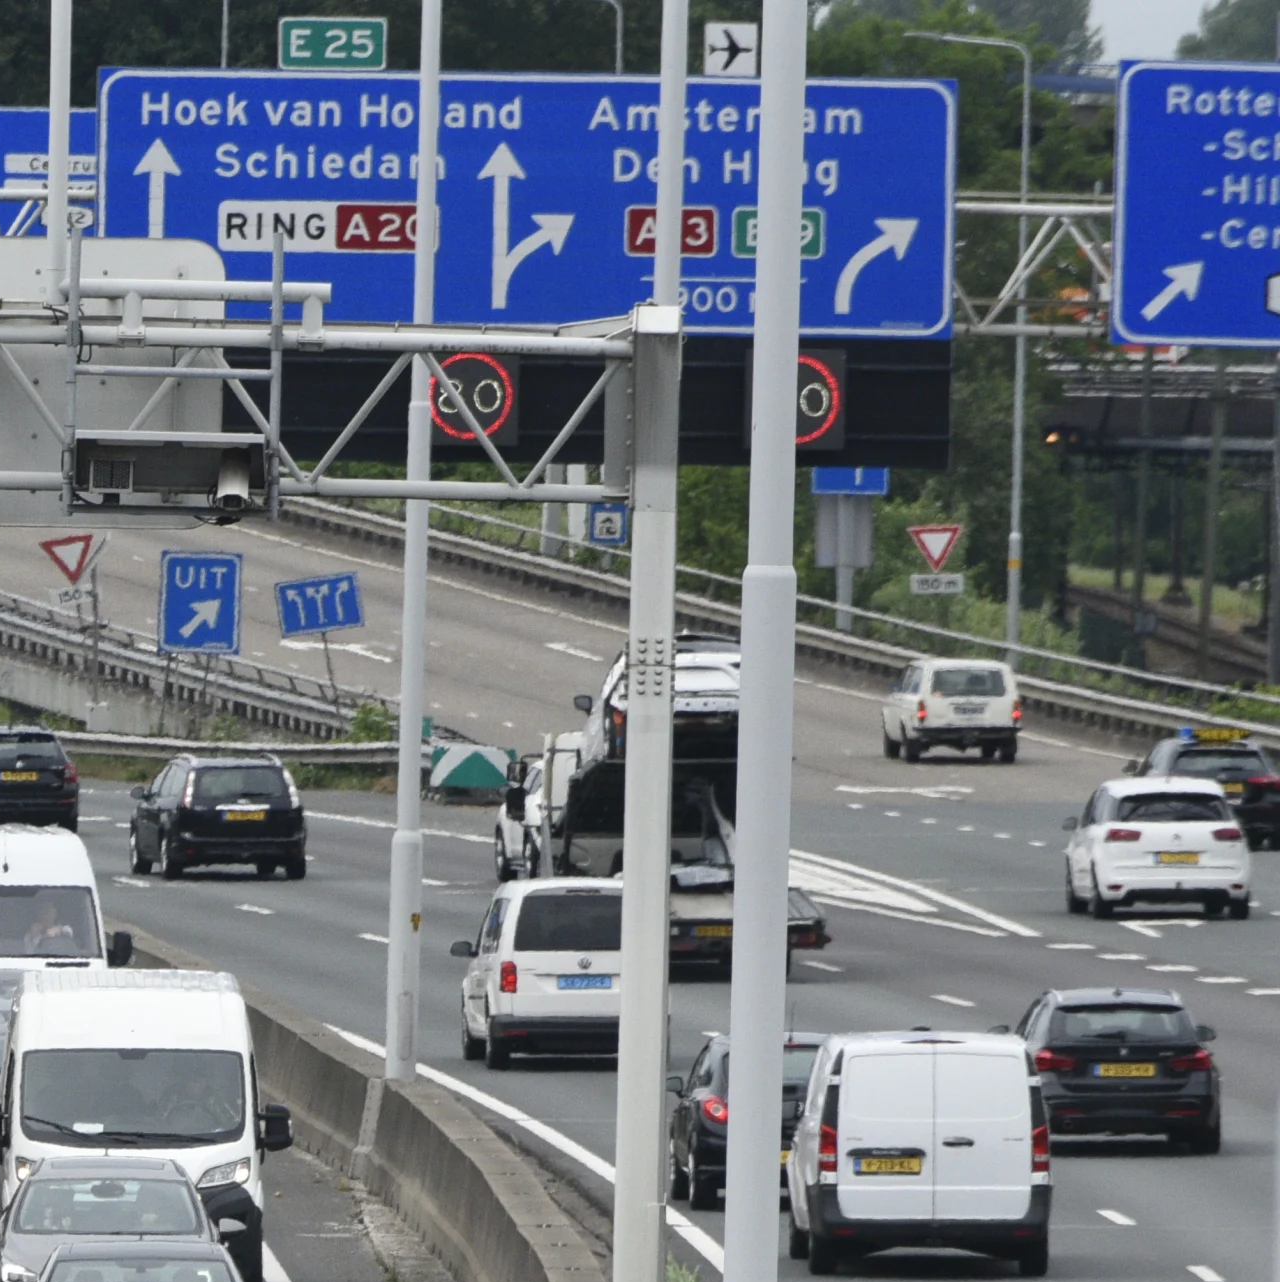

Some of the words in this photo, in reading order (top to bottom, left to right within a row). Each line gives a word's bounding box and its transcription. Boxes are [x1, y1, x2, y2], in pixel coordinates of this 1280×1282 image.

[289, 29, 312, 58] E
[324, 29, 375, 59] 25
[141, 92, 247, 126] Hoek
[265, 99, 341, 127] van
[360, 95, 522, 130] Hoand
[588, 97, 863, 134] Amterm
[1167, 84, 1280, 117] Rotte
[724, 151, 838, 196] Hg
[225, 213, 326, 241] RING
[635, 216, 709, 246] A3
[438, 379, 501, 413] 80
[799, 382, 830, 417] 0
[176, 567, 227, 590] UIT
